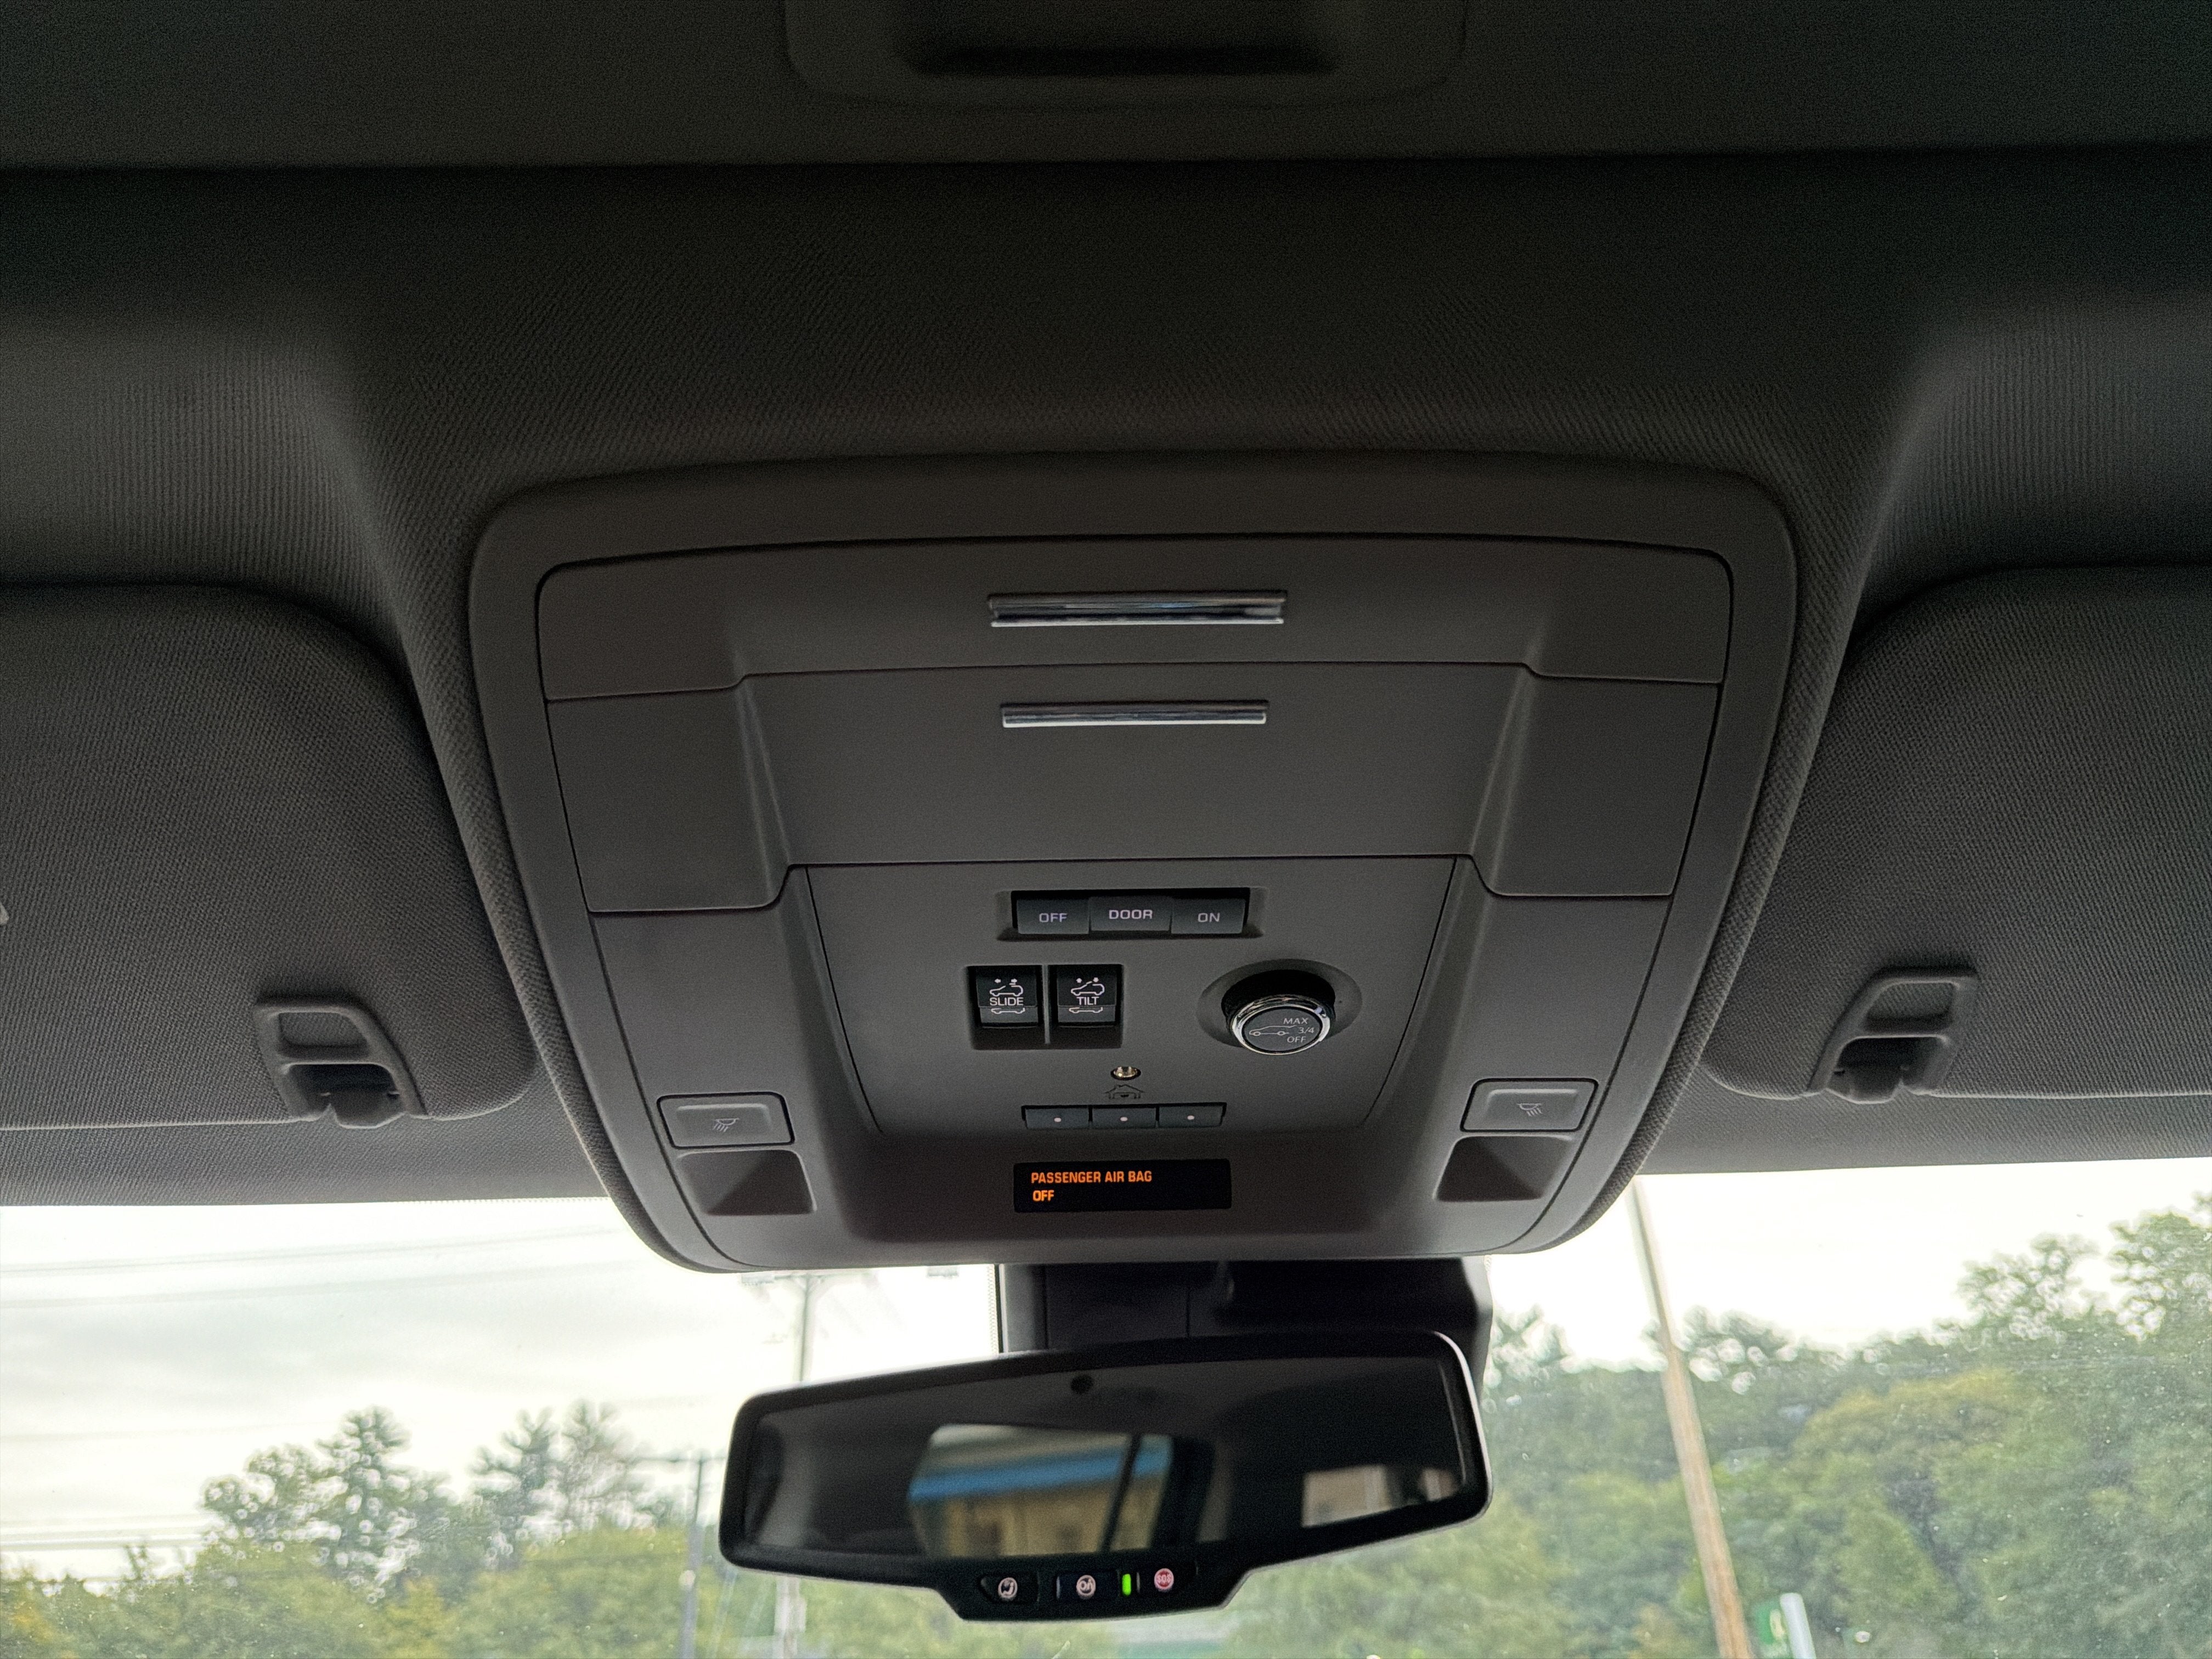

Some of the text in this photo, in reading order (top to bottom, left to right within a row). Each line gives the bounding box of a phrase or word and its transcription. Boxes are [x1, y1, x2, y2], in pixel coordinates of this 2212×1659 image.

[1039, 912, 1068, 923] OFF
[1108, 909, 1153, 920] DOOR
[1198, 912, 1220, 923] ON
[989, 996, 1024, 1006] SLIDE
[1076, 996, 1099, 1006] TILT
[1298, 1026, 1315, 1035] 3/4
[1286, 1035, 1306, 1043] OFF
[1031, 1170, 1153, 1184] PASSENGER AIR BAG
[1032, 1190, 1054, 1201] OFF
